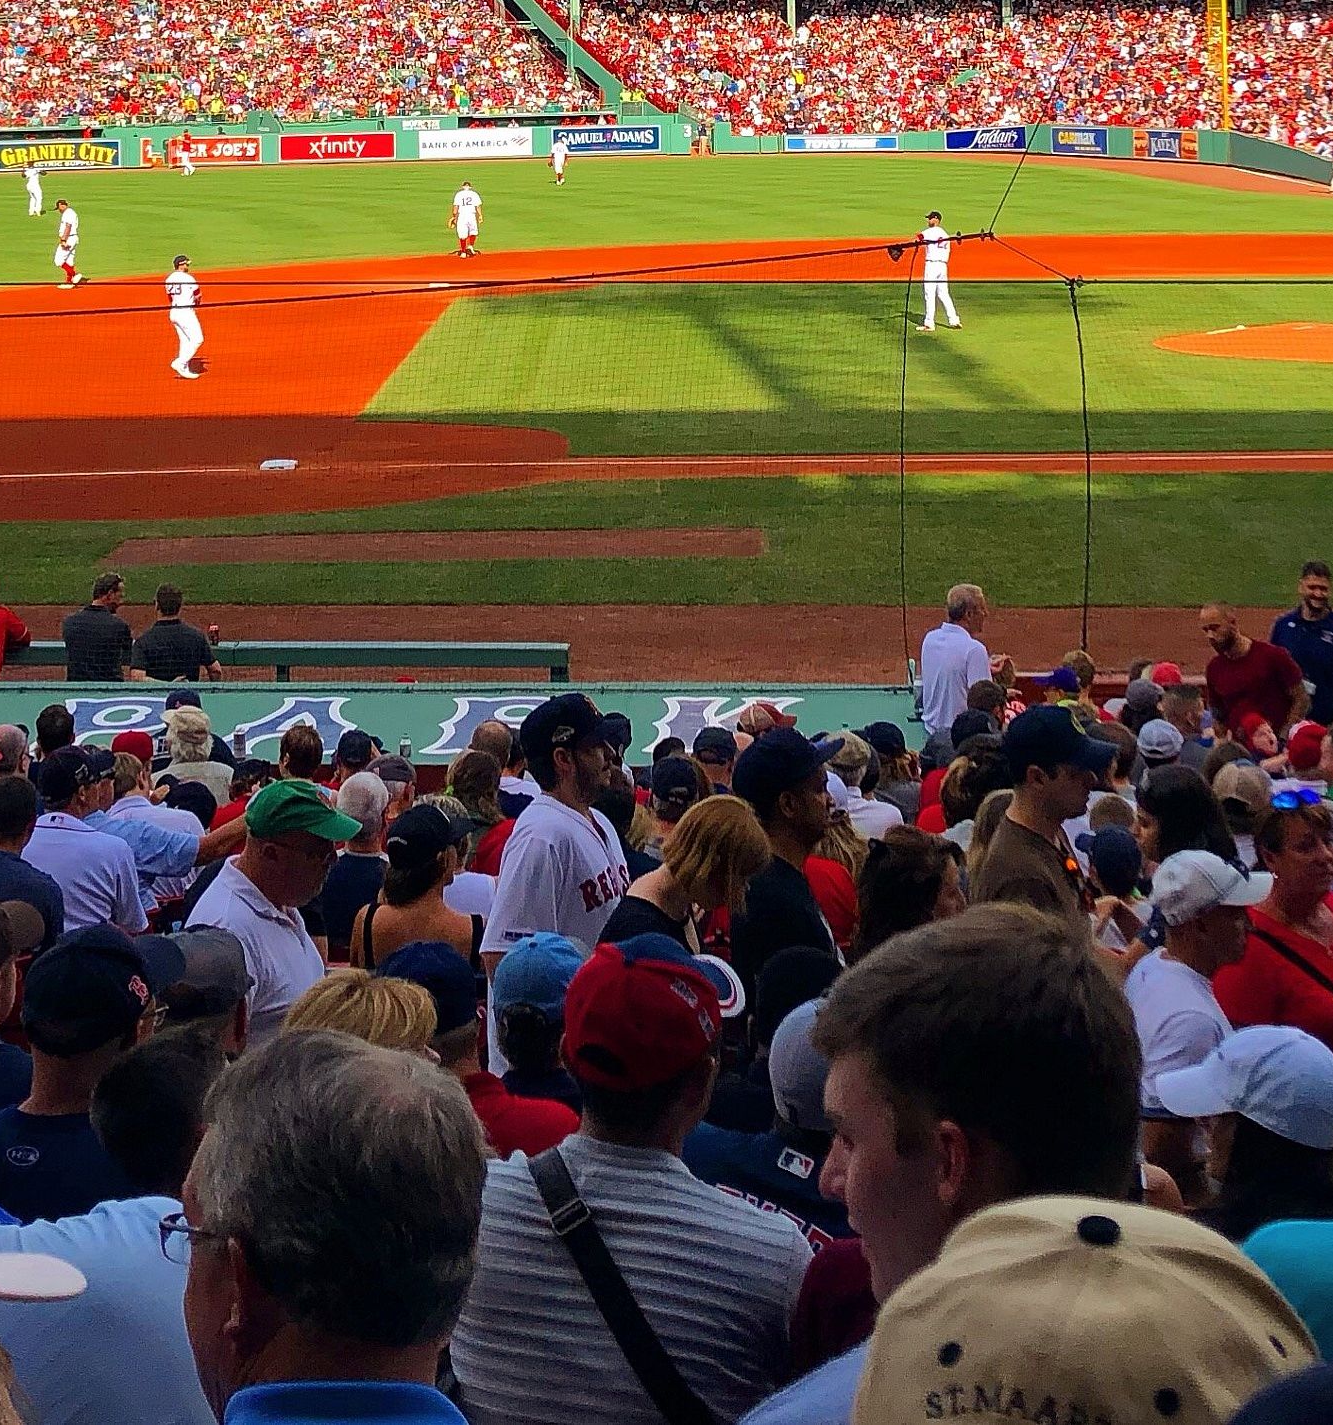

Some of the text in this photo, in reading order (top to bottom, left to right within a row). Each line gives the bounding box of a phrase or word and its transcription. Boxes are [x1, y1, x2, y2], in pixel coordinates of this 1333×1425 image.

[421, 141, 448, 150] BANK
[465, 139, 509, 148] AMERICA
[557, 131, 606, 147] SAMUEL
[610, 129, 655, 144] ADAMS
[968, 127, 1019, 150] Jordan's
[0, 144, 76, 167] GRANITE
[79, 142, 118, 164] CITY
[211, 142, 258, 158] JOE'S
[308, 136, 367, 159] xfinity
[461, 196, 473, 207] 12
